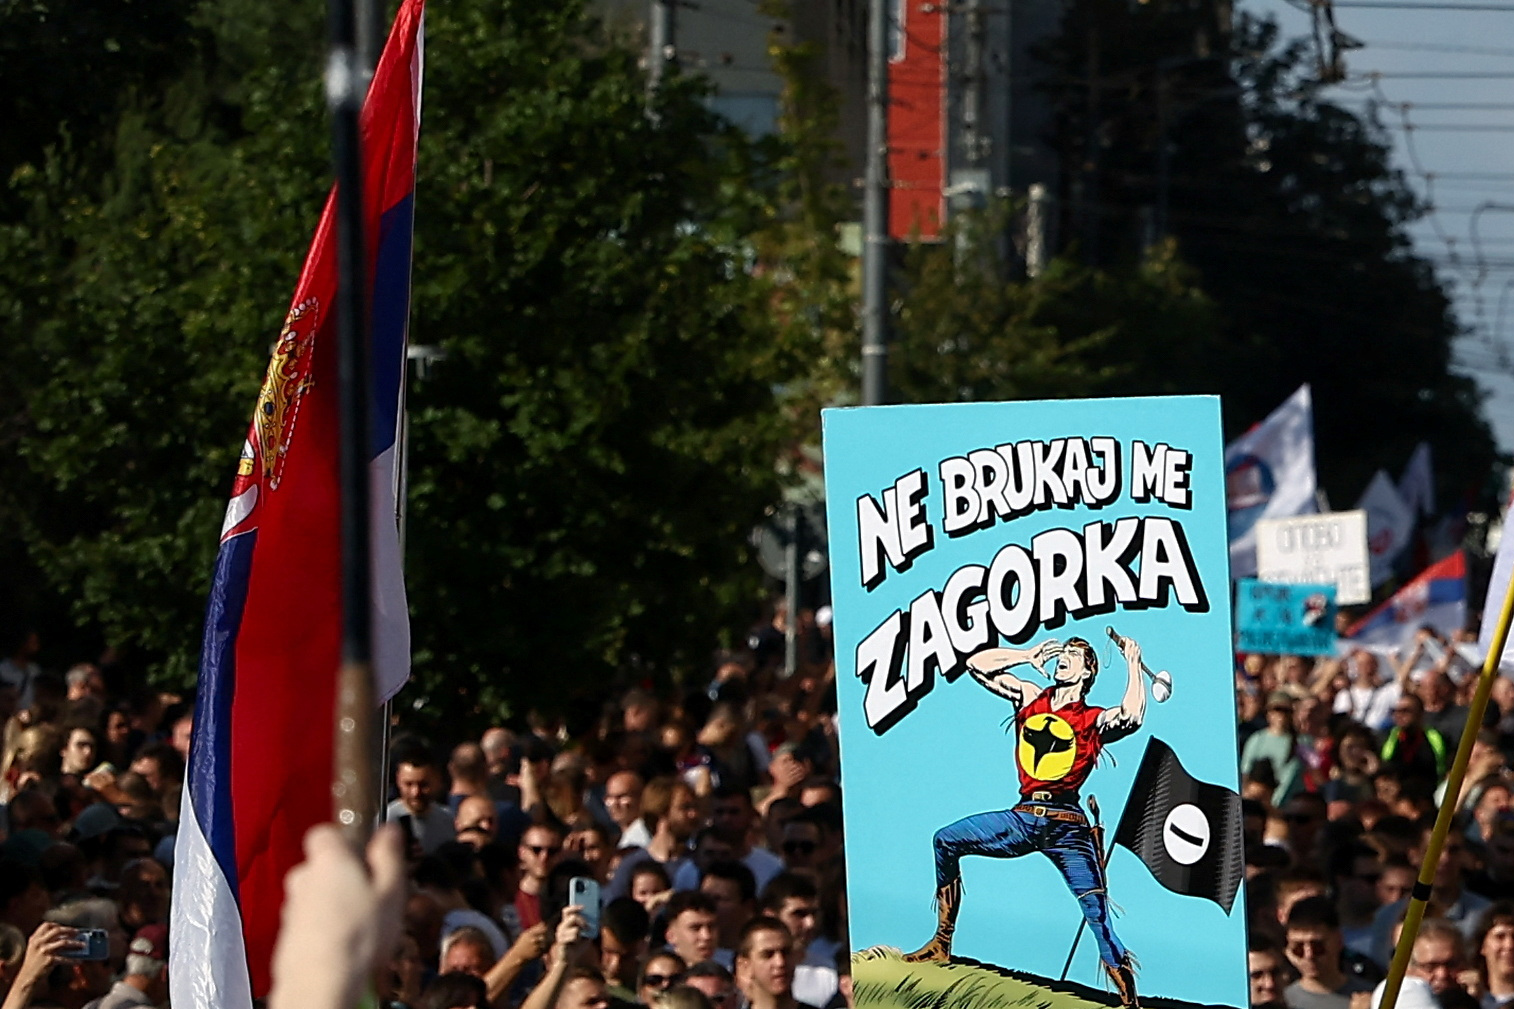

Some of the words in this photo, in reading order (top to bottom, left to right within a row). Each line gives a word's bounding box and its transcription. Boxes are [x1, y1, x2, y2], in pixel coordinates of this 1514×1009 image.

[857, 468, 933, 591] NE
[939, 437, 1120, 536] BRUKAJ
[1131, 440, 1193, 509] ME
[855, 517, 1210, 736] ZAGORKA
